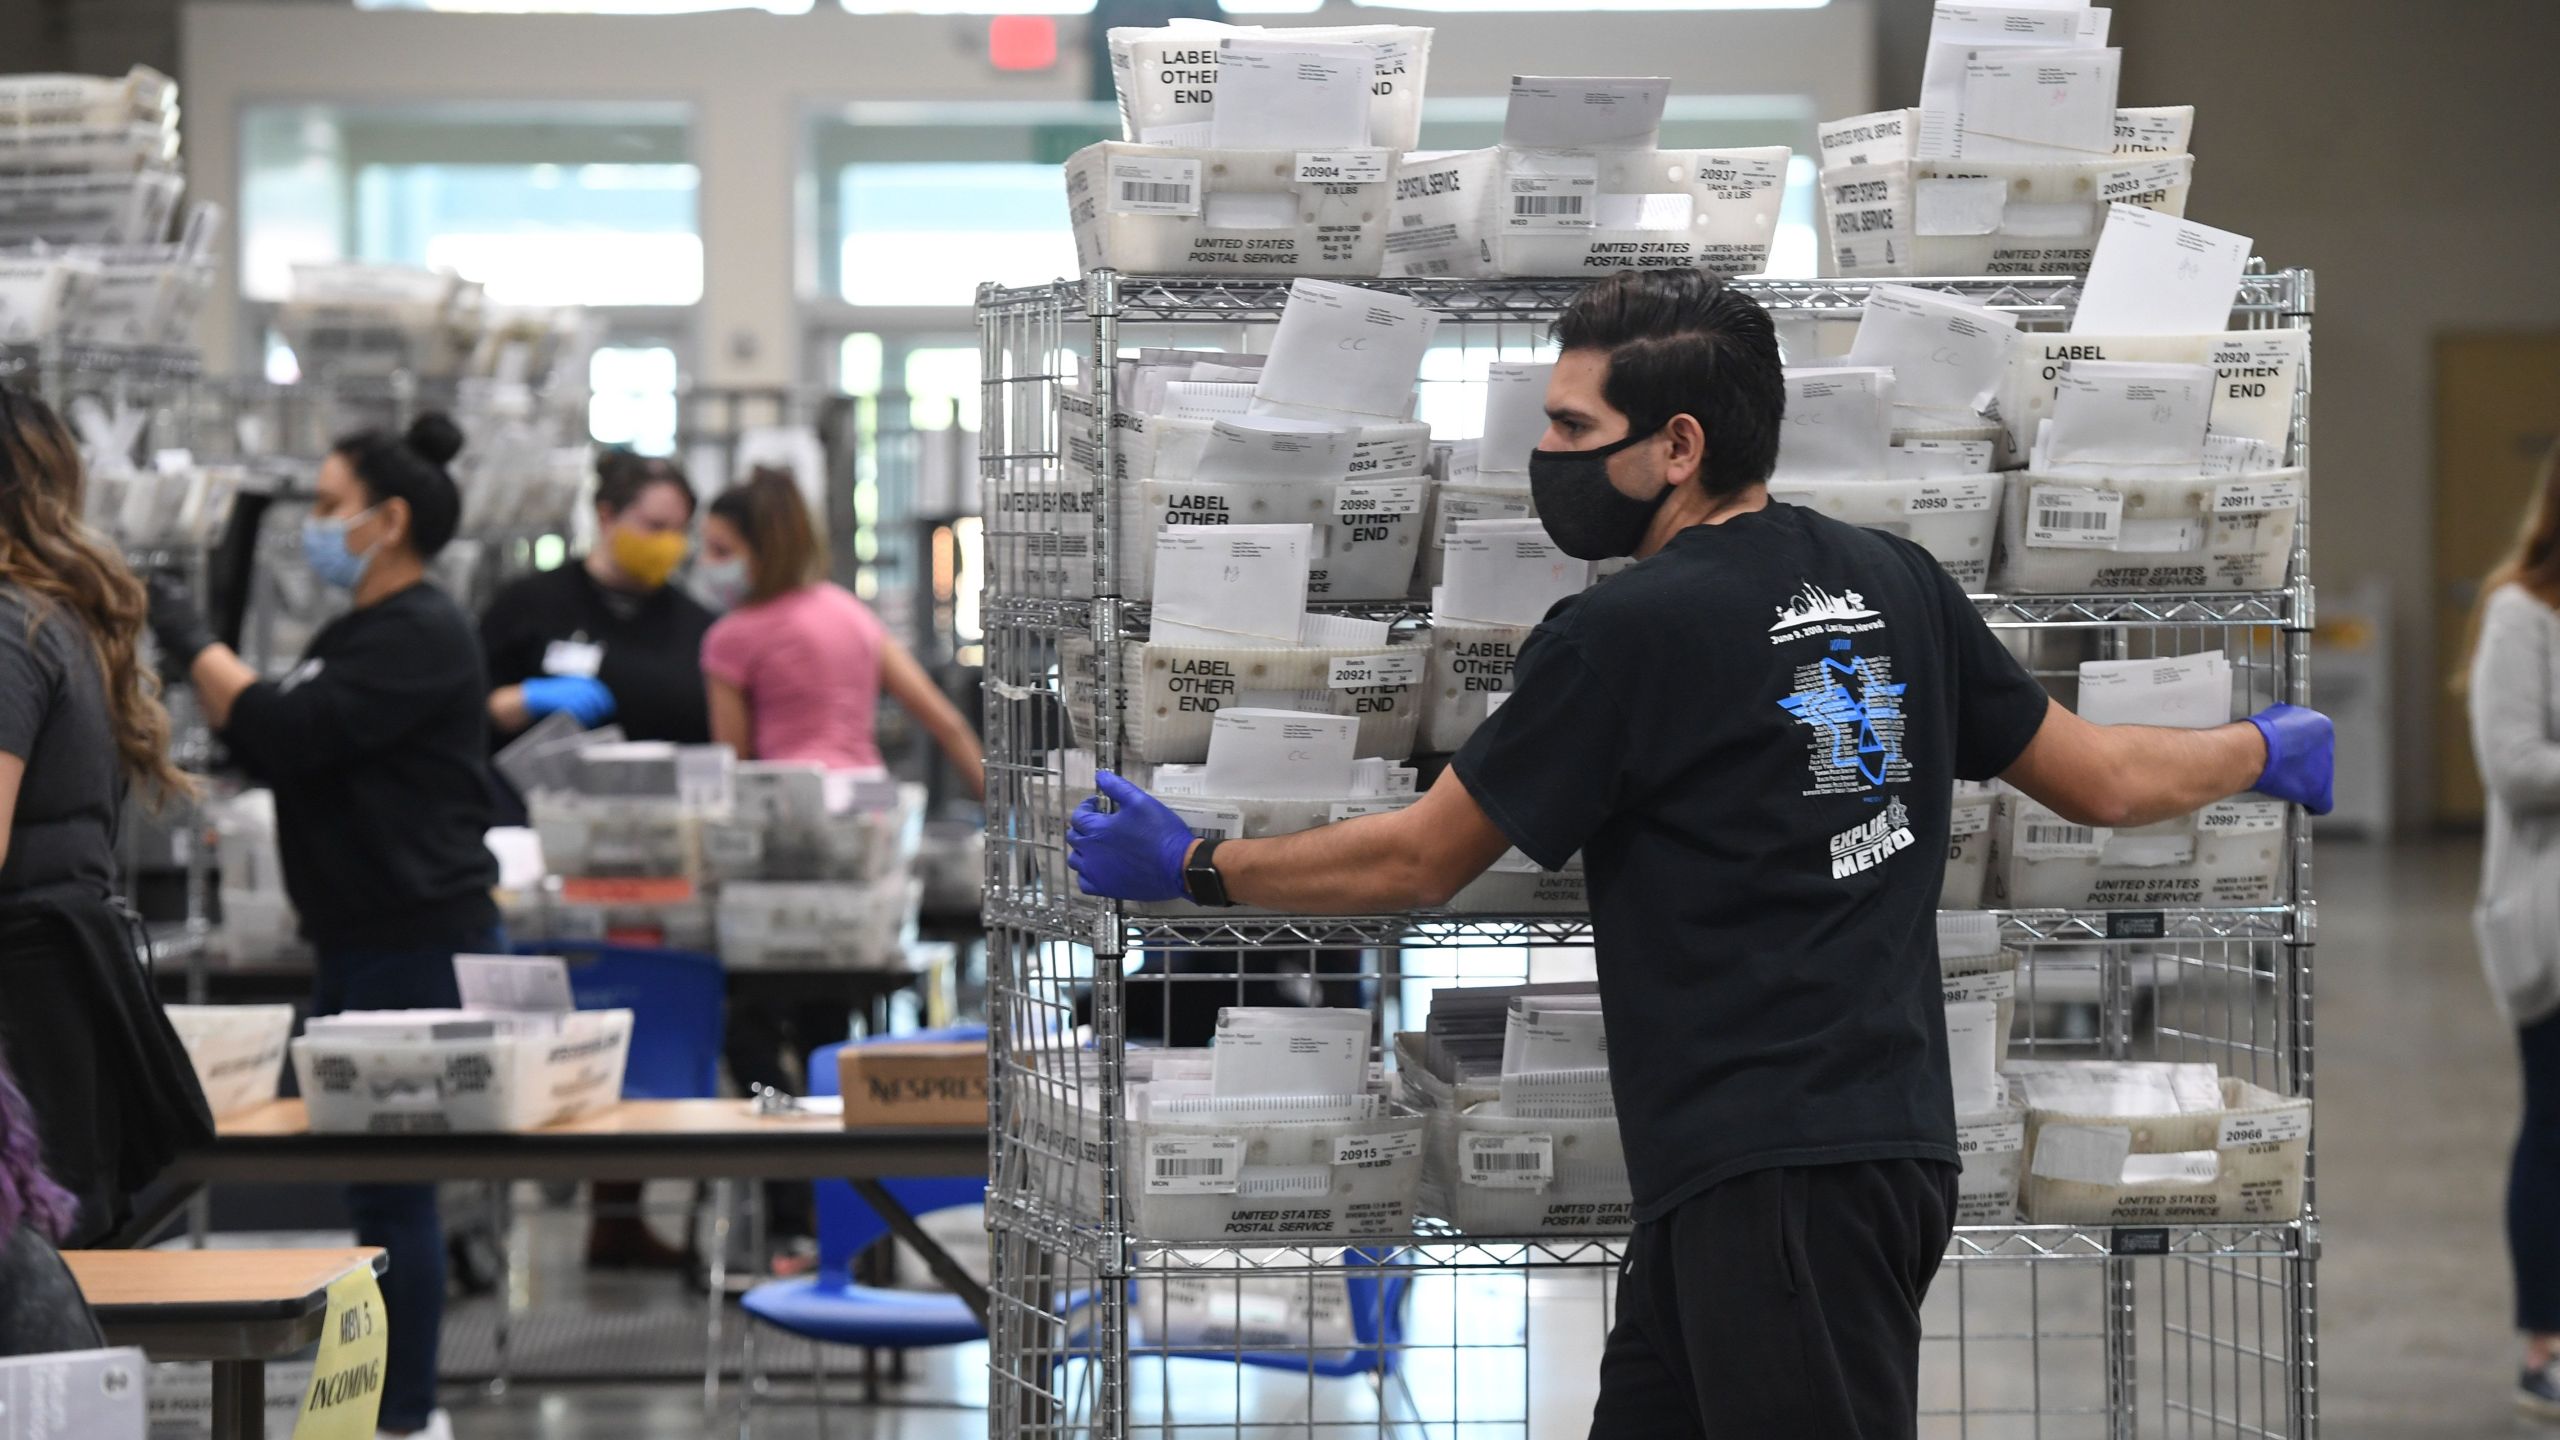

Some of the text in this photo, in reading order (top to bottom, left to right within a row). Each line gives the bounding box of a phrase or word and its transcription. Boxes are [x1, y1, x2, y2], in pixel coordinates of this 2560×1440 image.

[1162, 50, 1219, 65] LABEL
[1174, 89, 1213, 104] END
[1301, 166, 1339, 177] 20904
[1700, 168, 1737, 181] 20937
[2103, 179, 2140, 195] 20933
[1861, 208, 1893, 232] SERVICE
[1194, 238, 1295, 250] UNITED STATES
[1590, 242, 1690, 253] UNITED STATES
[1187, 252, 1298, 264] POSTAL SERVICE
[1993, 249, 2090, 260] UNITED STATES
[1583, 256, 1693, 266] POSTAL SERVICE
[1986, 262, 2091, 273] POSTAL SERVICE
[2045, 345, 2106, 361] LABEL
[2213, 352, 2250, 364] 20920
[2229, 384, 2266, 398] END
[1349, 460, 1378, 472] 0934
[1168, 494, 1229, 510] LABEL
[1340, 499, 1376, 510] 20998
[1911, 497, 1948, 510] 20950
[2221, 495, 2255, 507] 20911
[1165, 511, 1229, 525] OTHER
[1352, 526, 1389, 541] END
[2097, 565, 2206, 577] UNITED STATES
[2089, 575, 2208, 588] POSTAL SERVICE
[1770, 633, 1795, 645] June
[1456, 642, 1516, 657] LABEL
[1170, 658, 1236, 677] LABEL
[1452, 659, 1514, 675] OTHER
[1335, 669, 1372, 681] 20921
[1168, 677, 1235, 695] OTHER
[1464, 676, 1503, 692] END
[1178, 696, 1220, 713] END
[1355, 697, 1395, 713] END
[2204, 814, 2240, 826] 20997
[1832, 826, 1916, 880] METRO
[2095, 879, 2144, 889] UNITED
[2147, 878, 2200, 889] STATES
[2086, 891, 2203, 903] POSTAL SERVICE
[2225, 1128, 2262, 1142] 20966
[1340, 1148, 1377, 1160] 20915
[2118, 1194, 2217, 1205] UNITED STATES
[1231, 1208, 1331, 1220] UNITED STATES
[1547, 1203, 1632, 1215] UNITED STAT
[2111, 1206, 2221, 1217] POSTAL SERVICE
[1542, 1215, 1590, 1226] POSTAL
[1224, 1221, 1336, 1233] POSTAL SERVICE
[308, 1357, 380, 1413] INCOMING
